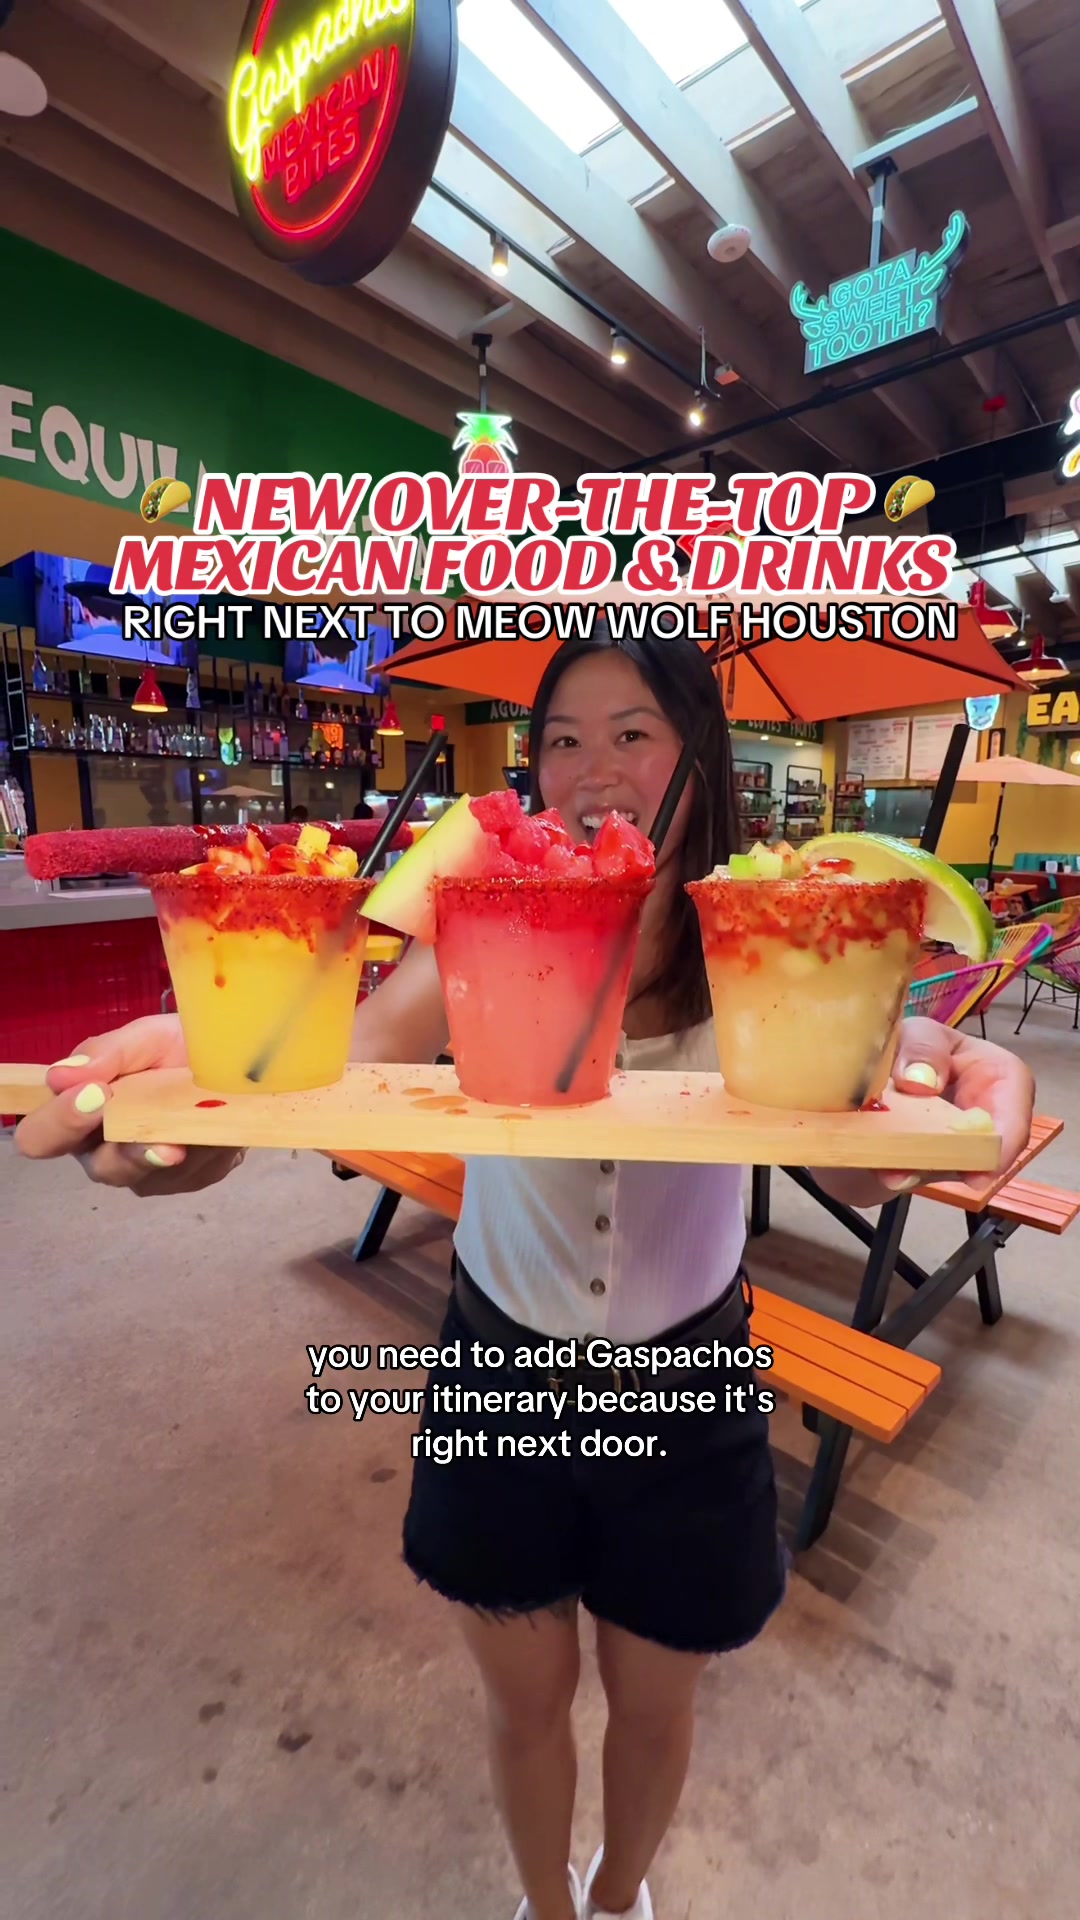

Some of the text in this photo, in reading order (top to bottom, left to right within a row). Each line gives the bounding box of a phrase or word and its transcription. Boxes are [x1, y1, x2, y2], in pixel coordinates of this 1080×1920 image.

[263, 50, 383, 180] MEXICAN
[285, 117, 359, 201] BITES
[821, 278, 920, 337] SWEET
[831, 258, 911, 307] GOTA
[808, 299, 933, 368] TOOTH?
